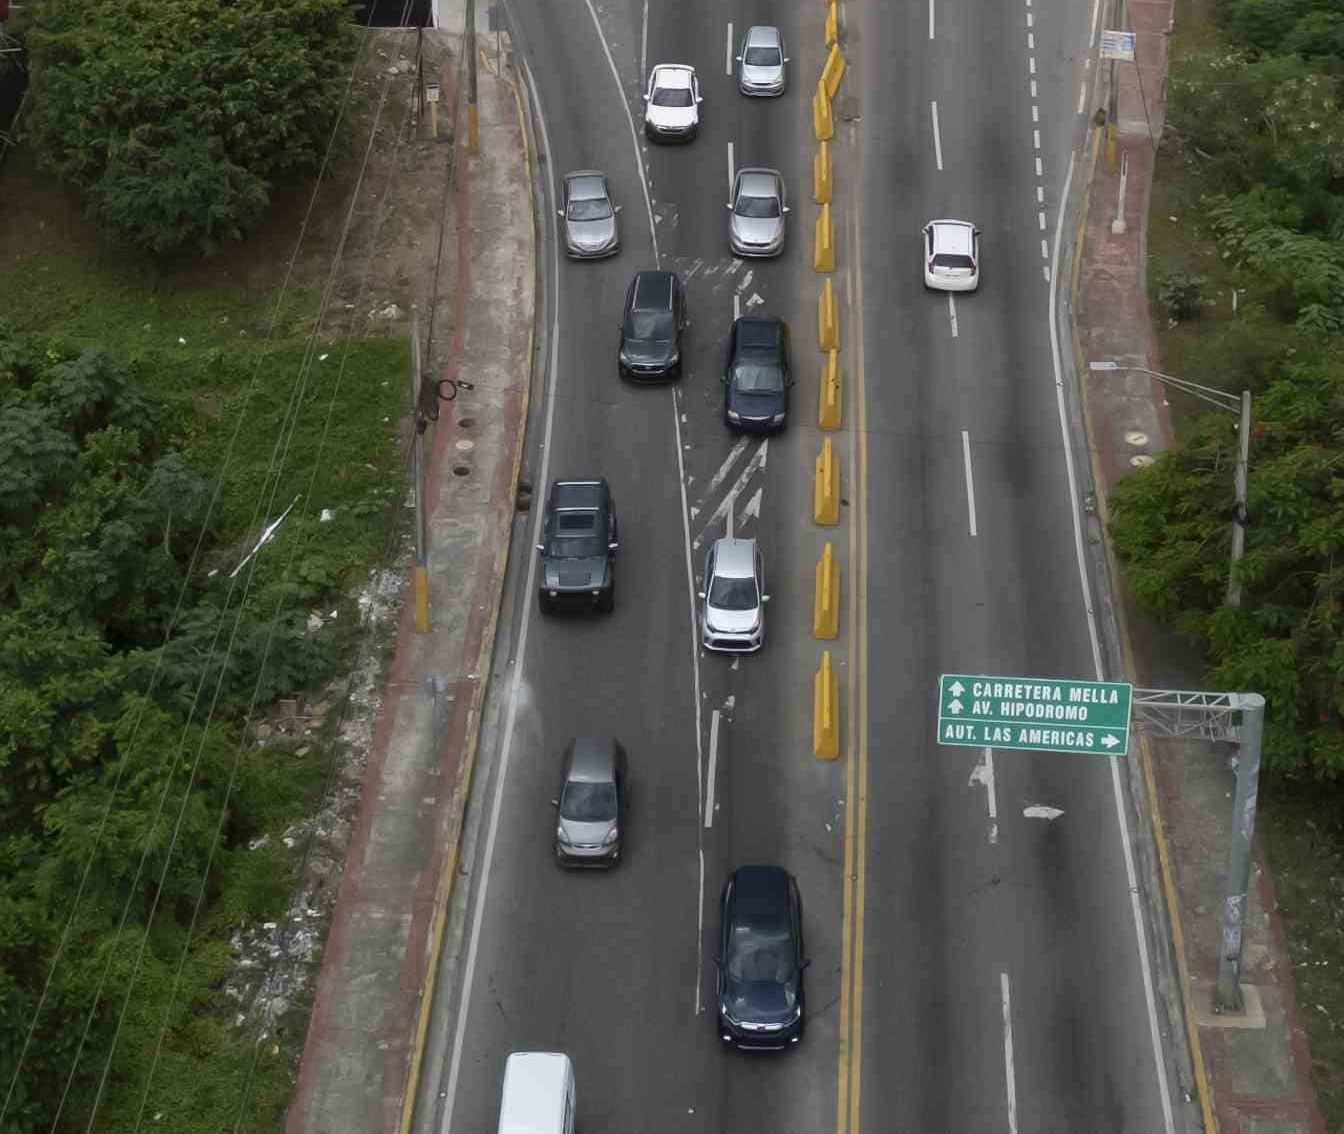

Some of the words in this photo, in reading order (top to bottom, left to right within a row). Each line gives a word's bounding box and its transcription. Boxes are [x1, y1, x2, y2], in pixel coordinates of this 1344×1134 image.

[972, 682, 1062, 701] CARRETERA
[1069, 687, 1119, 704] MELLA
[972, 701, 993, 715] AV.
[1000, 702, 1088, 720] HIPODROMO
[945, 724, 977, 740] AUT.
[983, 726, 1012, 742] LAS
[1018, 729, 1095, 747] AMERICAS
